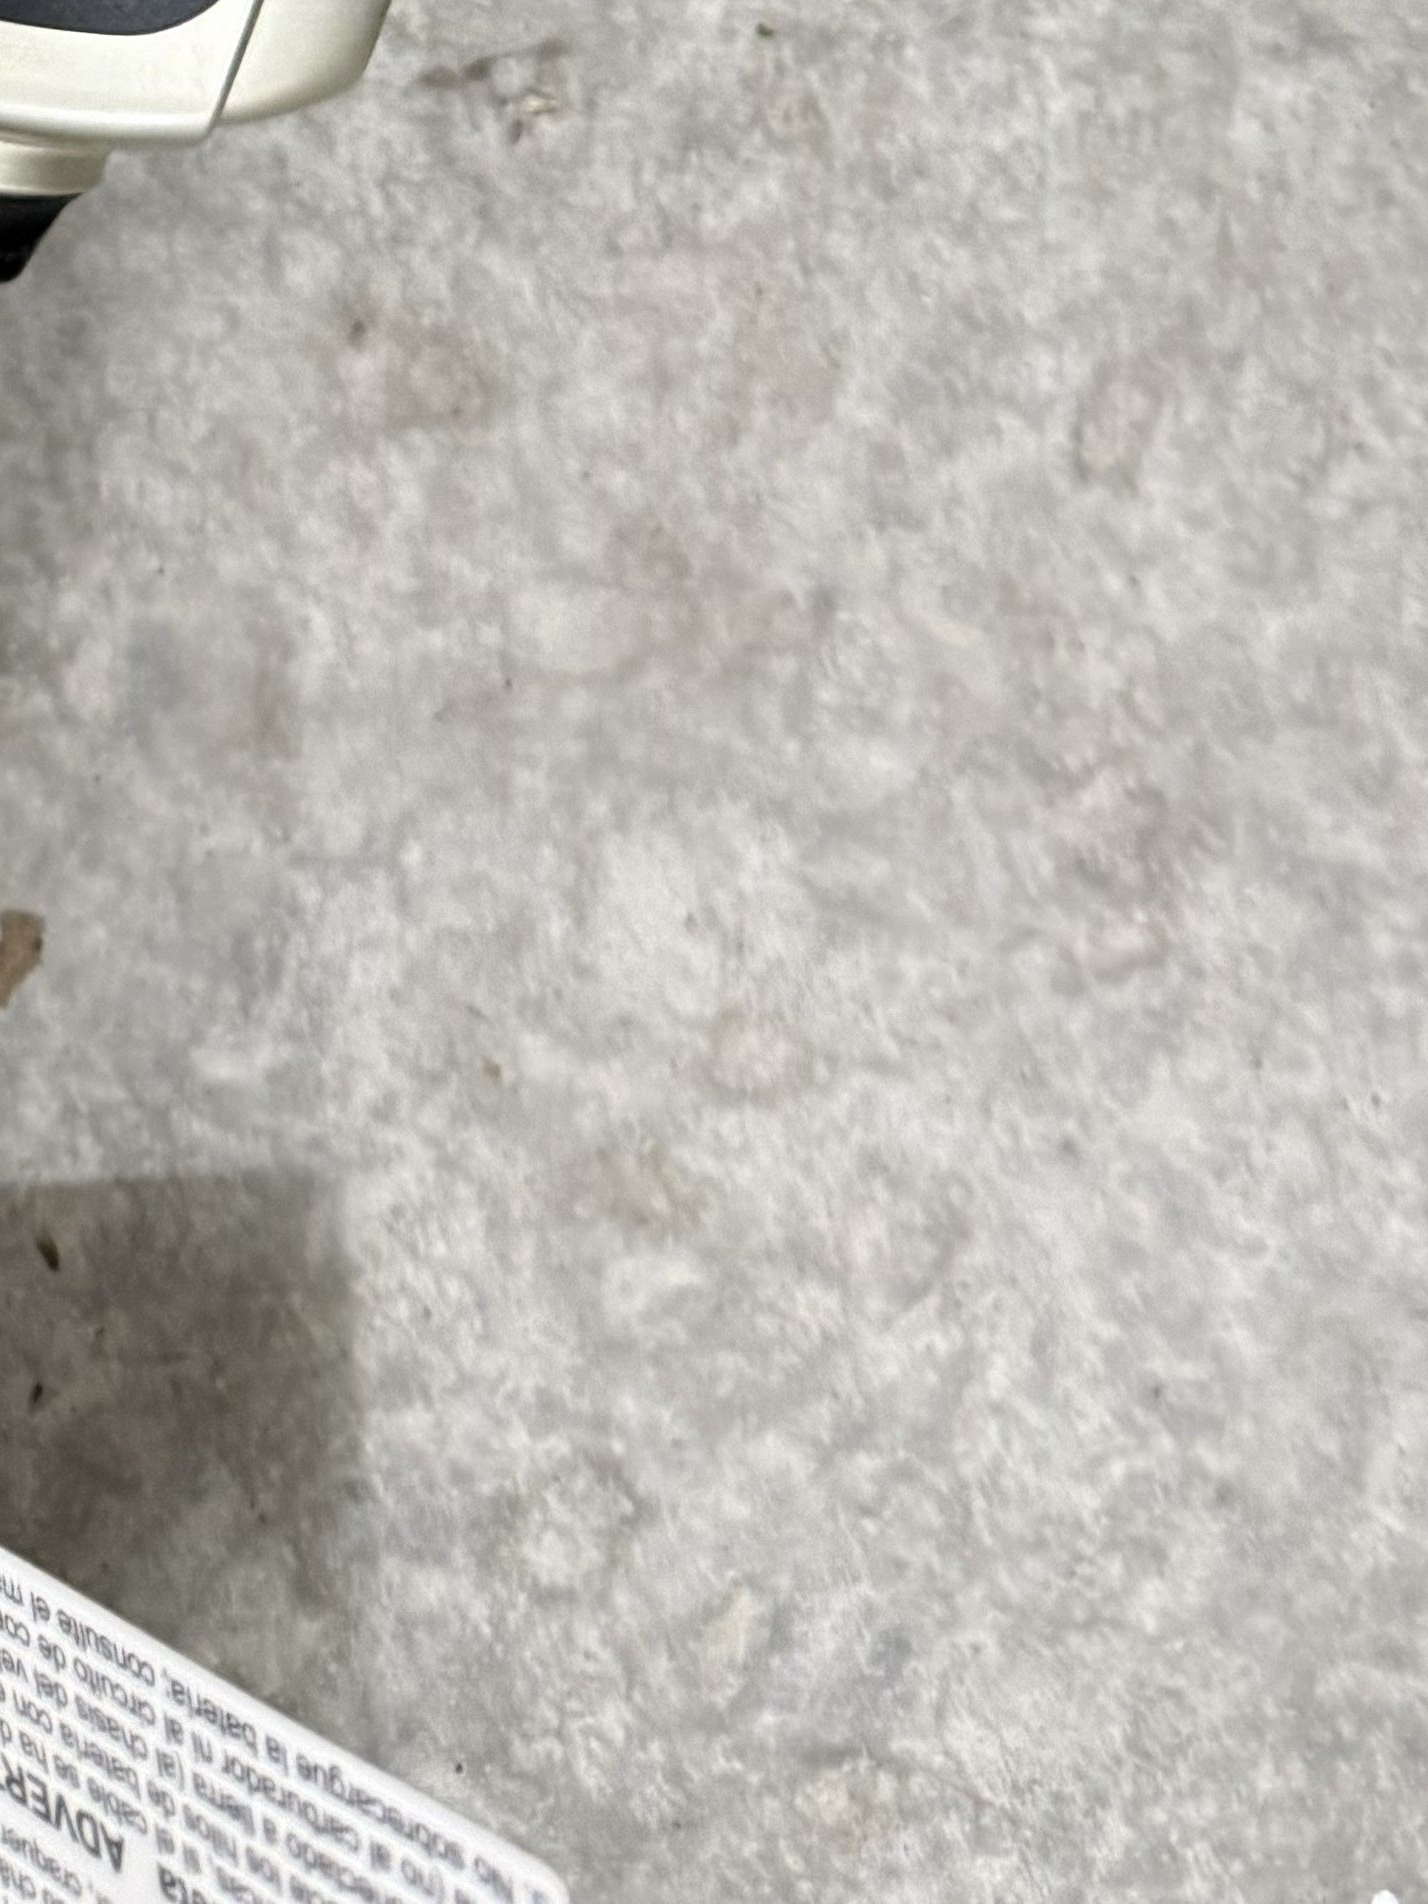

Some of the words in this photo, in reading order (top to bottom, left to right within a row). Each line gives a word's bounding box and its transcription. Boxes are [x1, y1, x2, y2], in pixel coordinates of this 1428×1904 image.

[30, 1592, 50, 1624] el
[37, 1634, 66, 1674] de
[57, 1610, 155, 1687] consulte
[33, 1667, 67, 1709] del
[74, 1657, 156, 1727] circuito
[12, 1688, 52, 1734] con
[20, 1730, 49, 1774] ha
[265, 1734, 288, 1776] la
